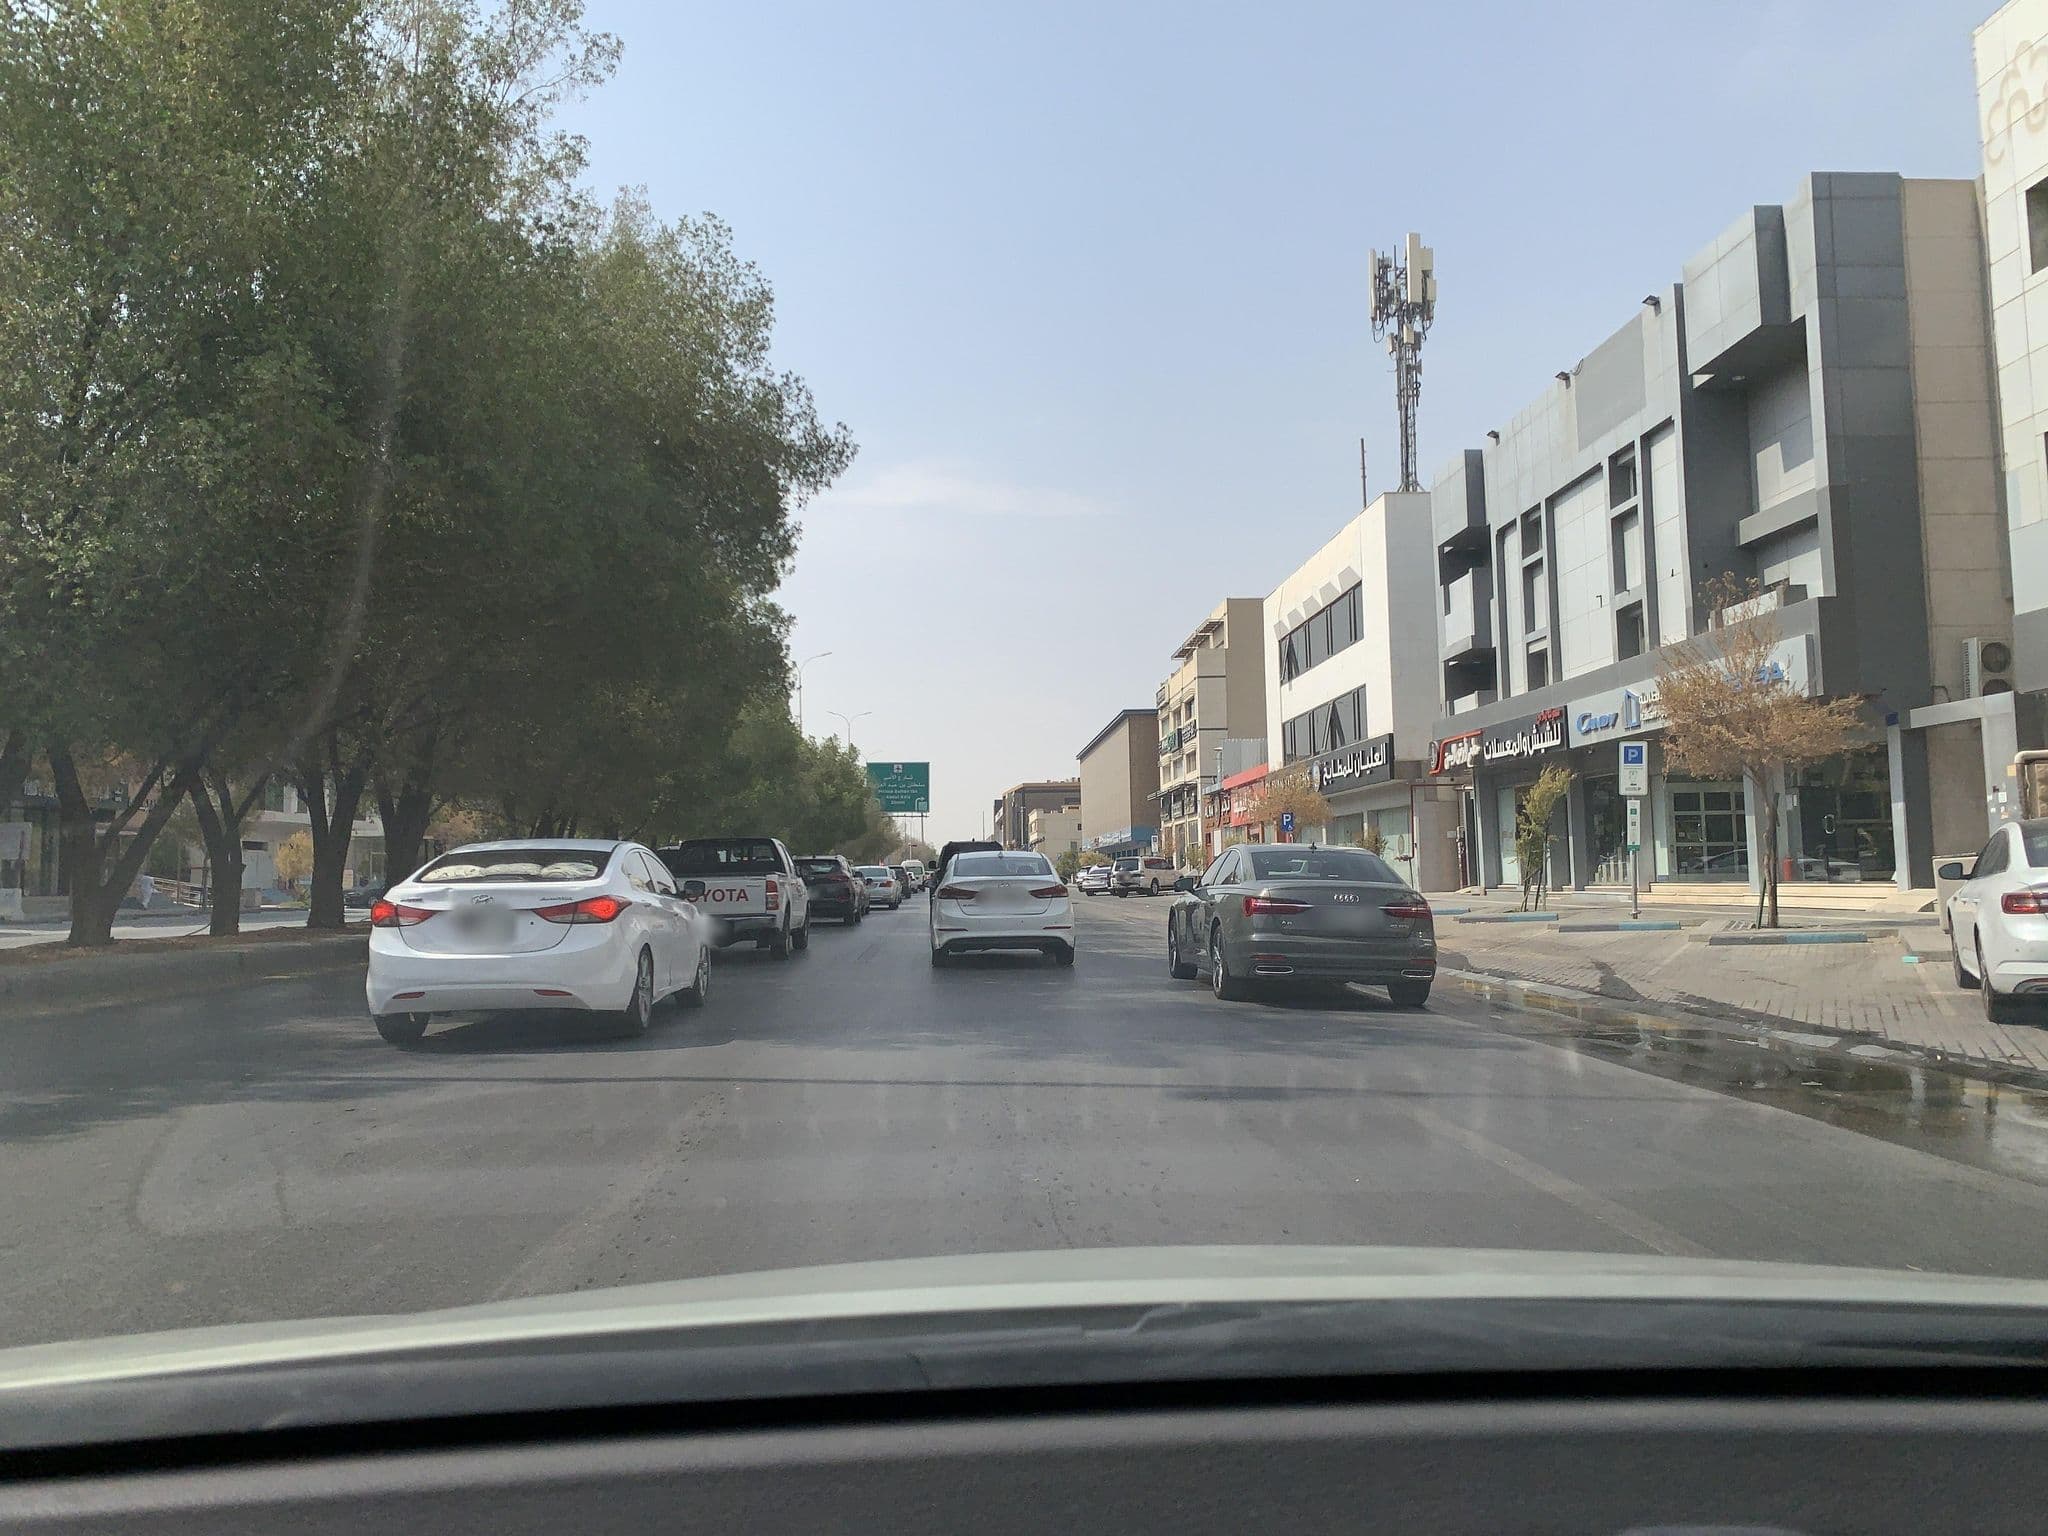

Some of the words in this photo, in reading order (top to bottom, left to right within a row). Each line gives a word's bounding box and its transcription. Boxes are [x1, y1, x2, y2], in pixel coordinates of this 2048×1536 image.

[1354, 742, 1387, 778] العليان
[1628, 749, 1639, 762] P
[1322, 753, 1354, 786] للمطابخ
[1283, 814, 1292, 826] P
[686, 888, 750, 903] YOTA
